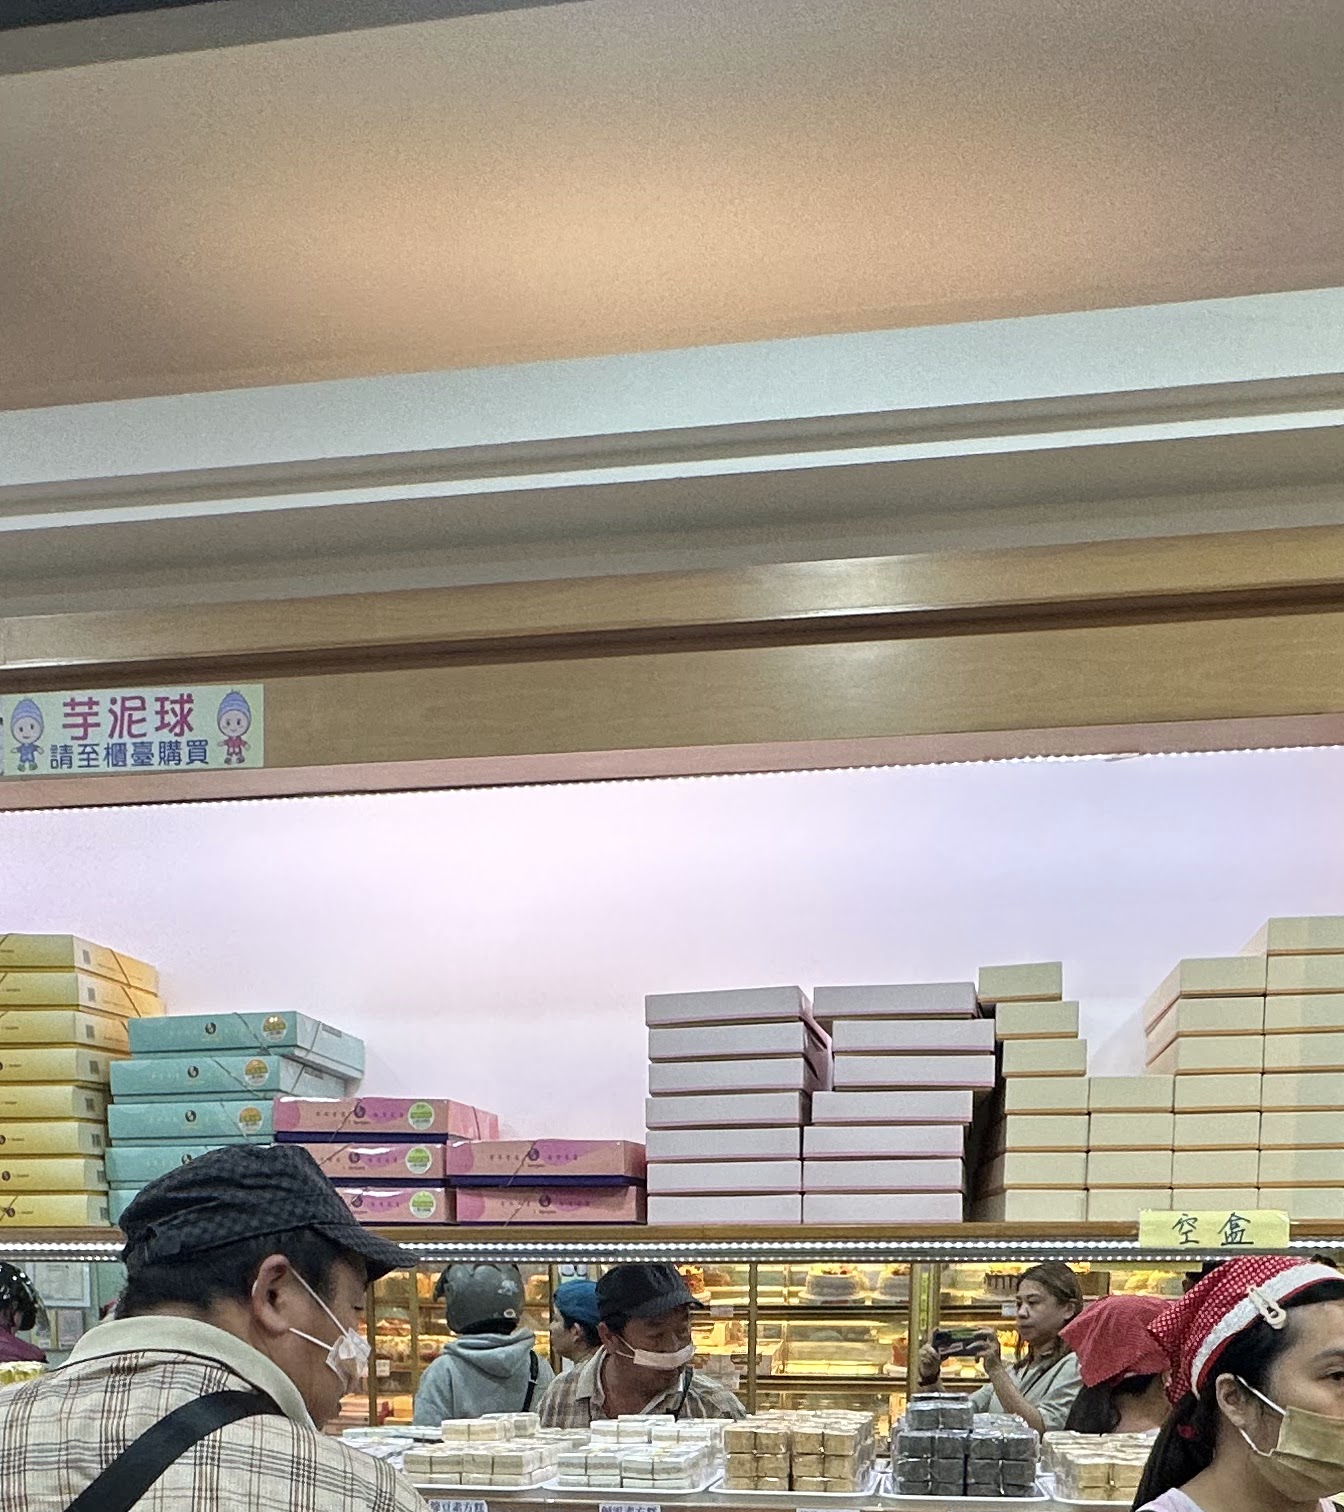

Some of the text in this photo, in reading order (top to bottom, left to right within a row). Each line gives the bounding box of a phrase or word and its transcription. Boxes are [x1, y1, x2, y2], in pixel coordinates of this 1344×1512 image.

[61, 692, 195, 741] 芋泥球
[50, 739, 210, 770] 請至櫃臺購買
[1171, 1211, 1255, 1247] 空盒
